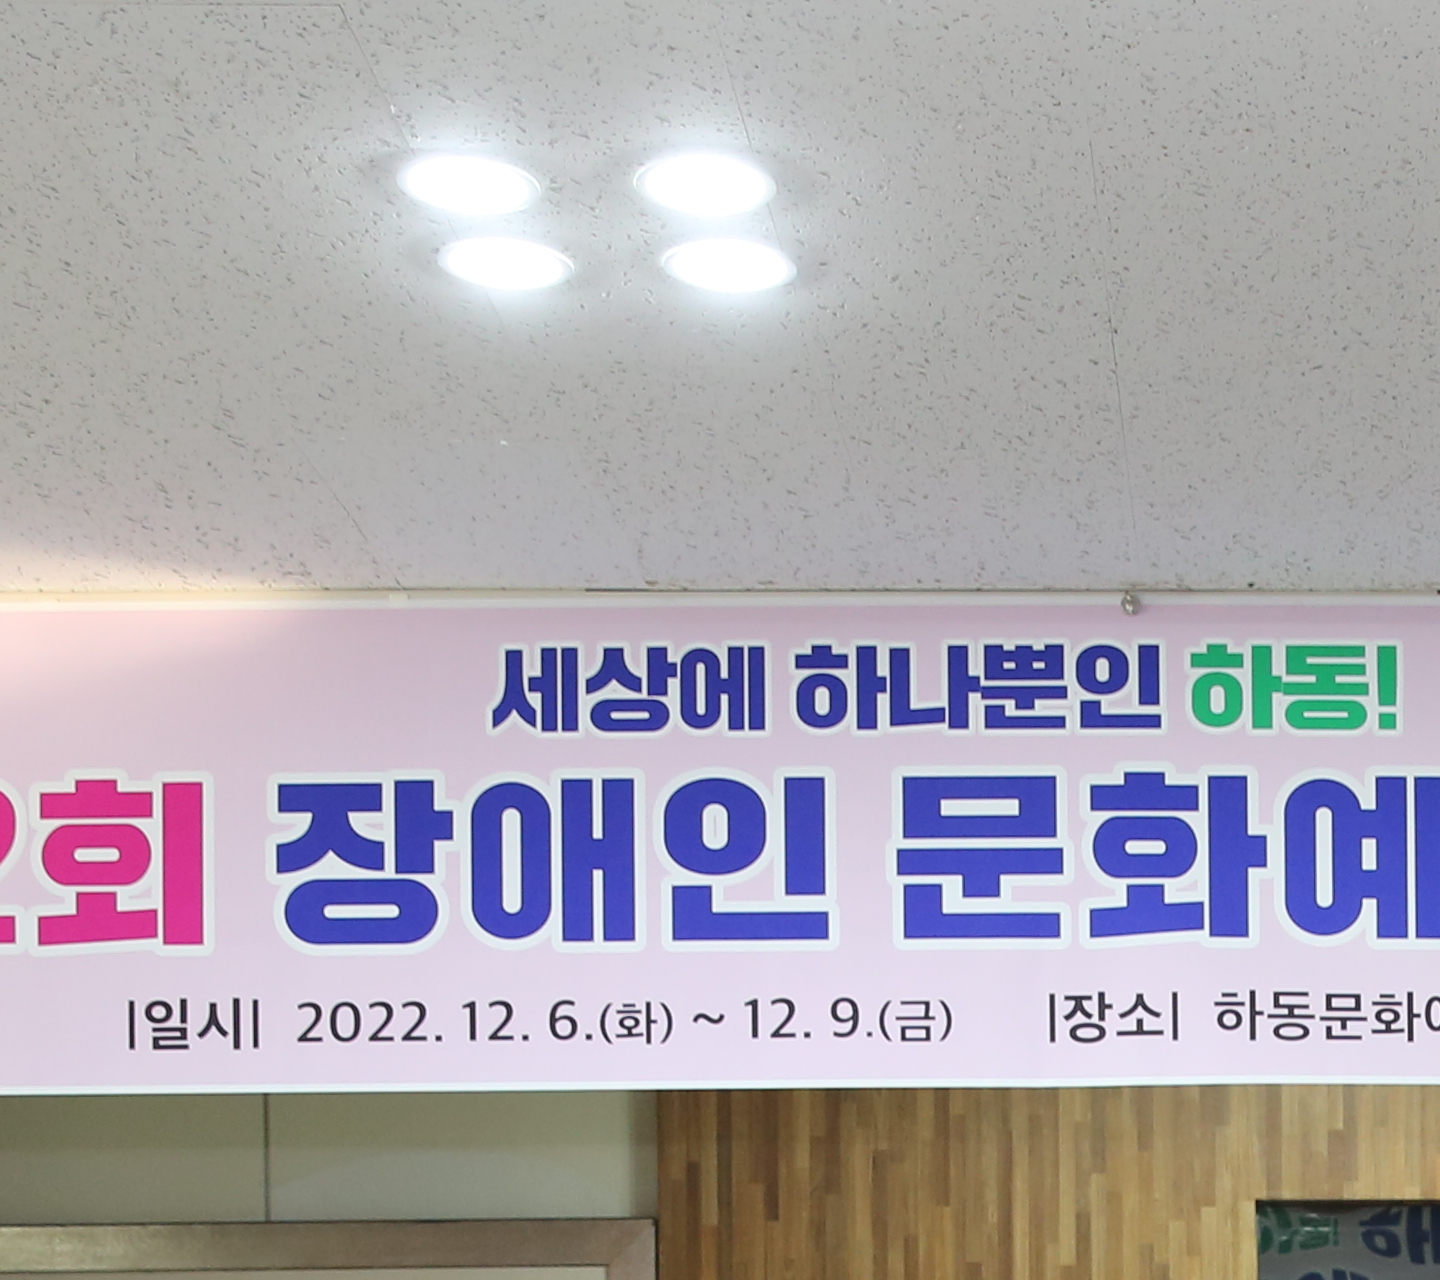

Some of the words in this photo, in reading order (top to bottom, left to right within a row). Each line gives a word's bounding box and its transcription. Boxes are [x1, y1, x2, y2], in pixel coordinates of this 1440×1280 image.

[492, 645, 766, 732] 세상에
[796, 644, 1162, 731] 하나뿐인
[1190, 643, 1398, 730] 하동!
[276, 777, 830, 946] 장애인
[296, 1001, 442, 1042] 2022.
[462, 1001, 529, 1041] 12.
[549, 1000, 673, 1045] 6.(화)
[745, 998, 812, 1038] 12.
[831, 997, 952, 1042] 9.(금)
